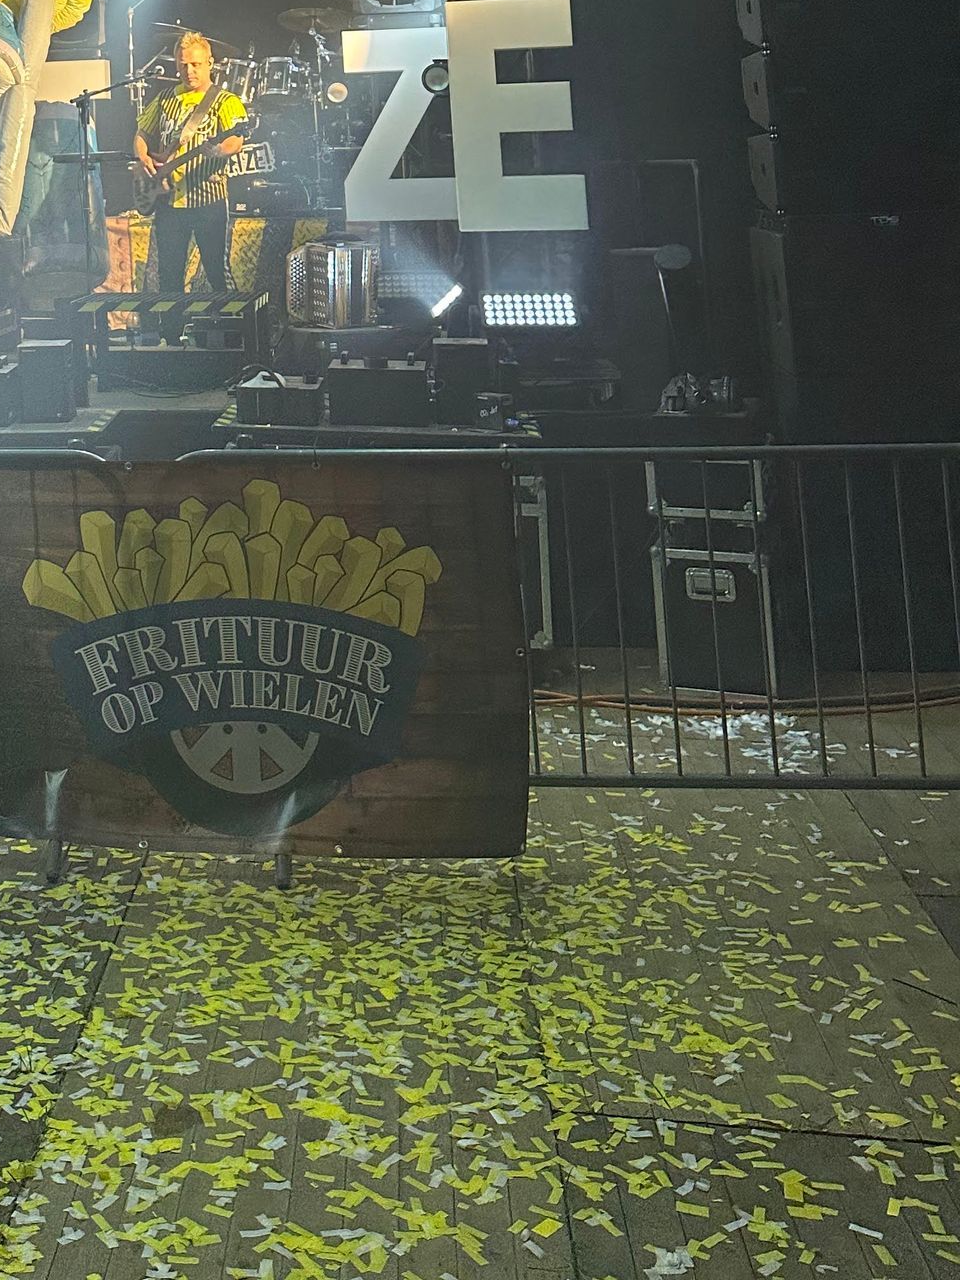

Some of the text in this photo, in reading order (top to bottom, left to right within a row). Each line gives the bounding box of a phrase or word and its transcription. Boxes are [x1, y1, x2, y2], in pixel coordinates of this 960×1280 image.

[74, 616, 392, 695] FRITUUR
[101, 670, 384, 736] OP WIELEN
